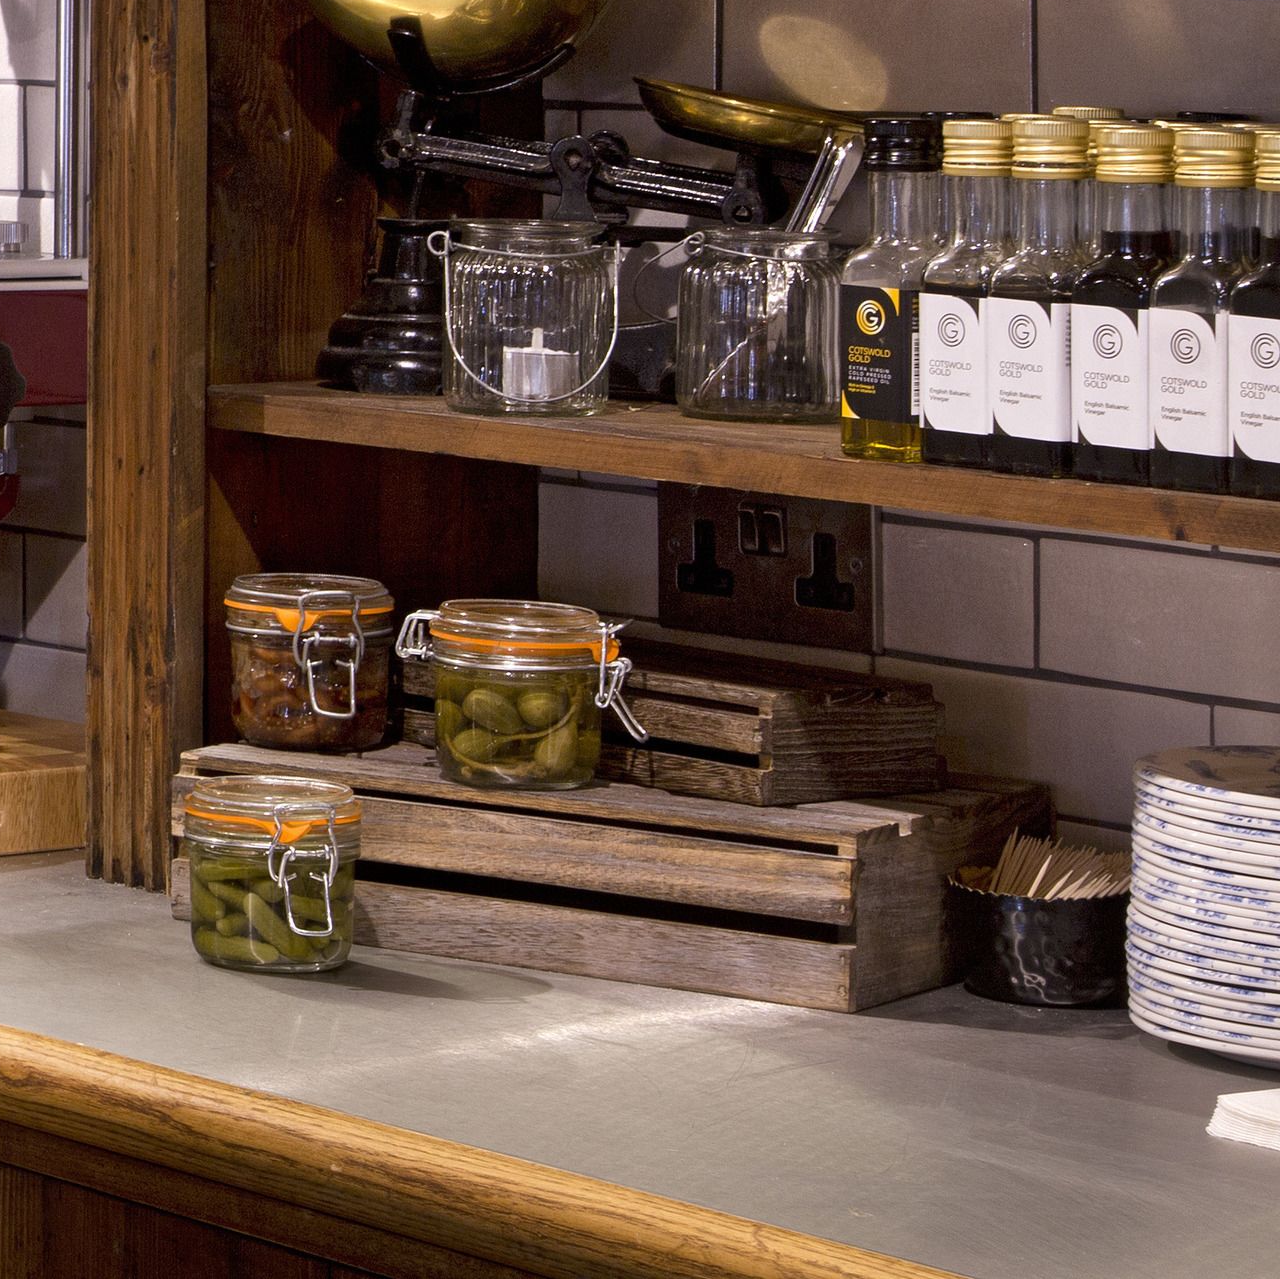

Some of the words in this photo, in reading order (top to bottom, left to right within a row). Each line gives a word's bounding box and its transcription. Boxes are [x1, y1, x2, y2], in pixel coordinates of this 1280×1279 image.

[848, 346, 891, 358] COTSWOLD
[848, 354, 871, 363] GOLD
[929, 359, 972, 371] COTSWOLD
[999, 360, 1043, 373] COTSWOLD
[866, 372, 892, 380] PRESSED
[929, 367, 951, 377] GOLD
[999, 369, 1022, 379] GOLD
[1083, 371, 1130, 383] COTSWOLD
[1083, 380, 1107, 389] GOLD
[1161, 376, 1207, 389] COTSWOLD
[1240, 381, 1280, 394] COTSWOL
[1161, 385, 1185, 395] GOLD
[1240, 389, 1265, 400] GOLD
